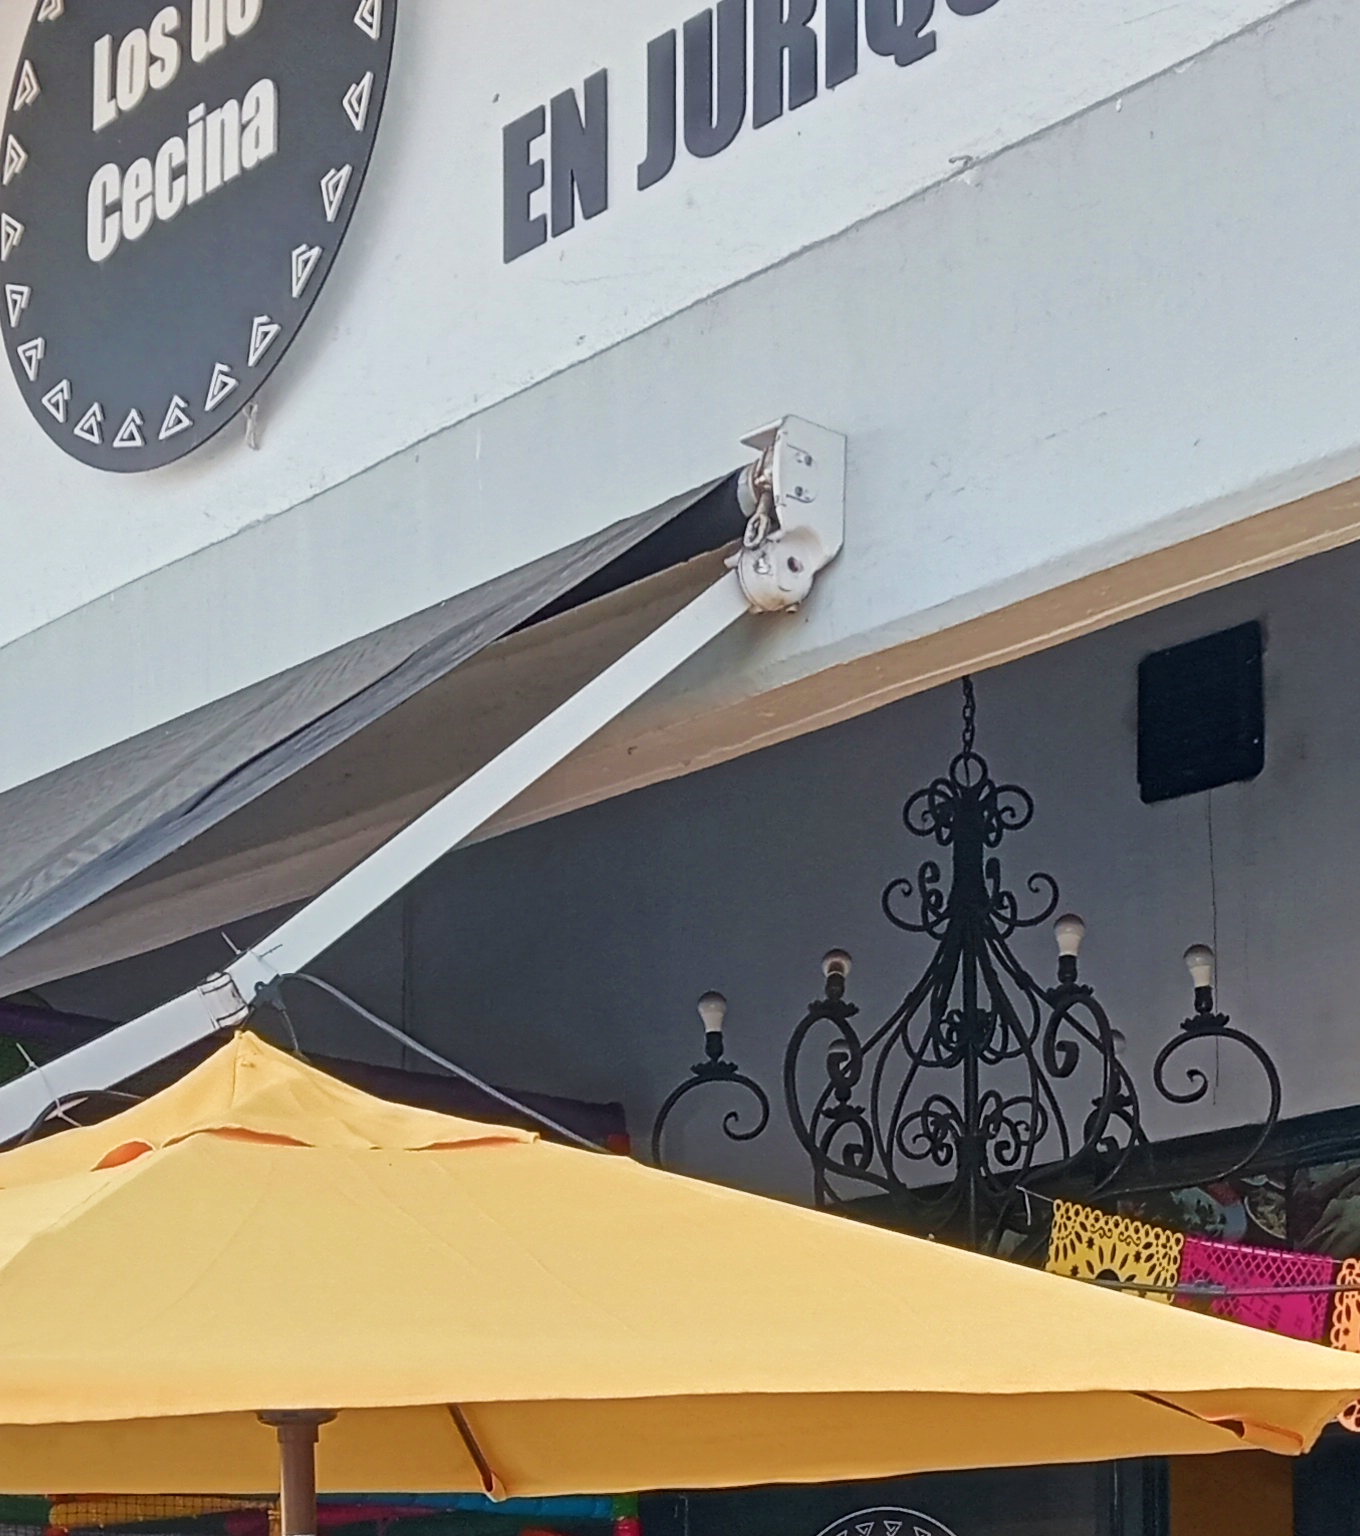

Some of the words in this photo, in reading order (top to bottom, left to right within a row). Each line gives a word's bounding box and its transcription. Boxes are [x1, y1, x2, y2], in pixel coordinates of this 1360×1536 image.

[92, 5, 181, 134] Los
[86, 78, 279, 263] Cecina
[502, 67, 608, 264] EN
